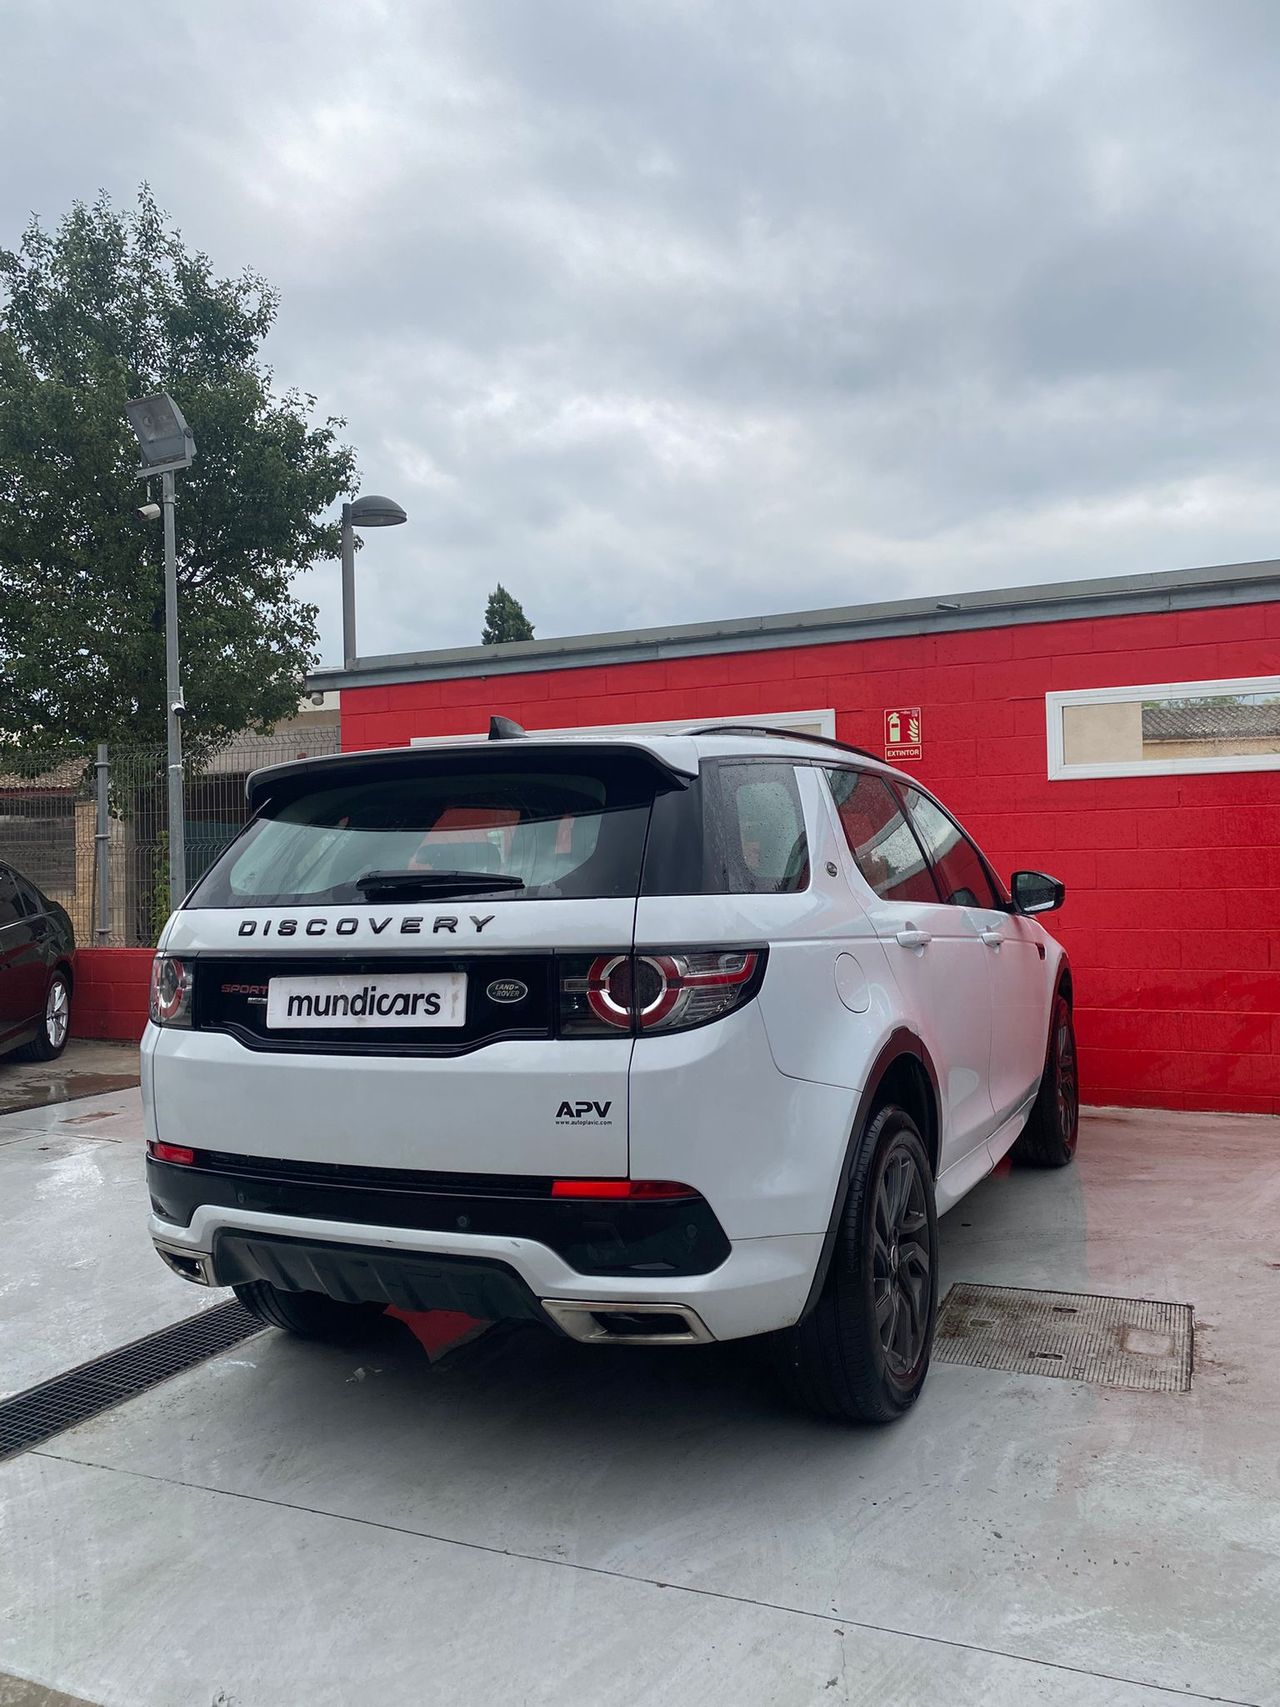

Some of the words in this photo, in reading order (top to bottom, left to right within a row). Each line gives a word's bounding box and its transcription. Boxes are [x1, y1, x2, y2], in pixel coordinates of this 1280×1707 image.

[887, 749, 920, 757] EXTINTOR
[238, 915, 495, 936] DISCOVERY
[221, 984, 268, 994] SPORT
[287, 986, 441, 1017] mundicars
[555, 1101, 612, 1118] APV
